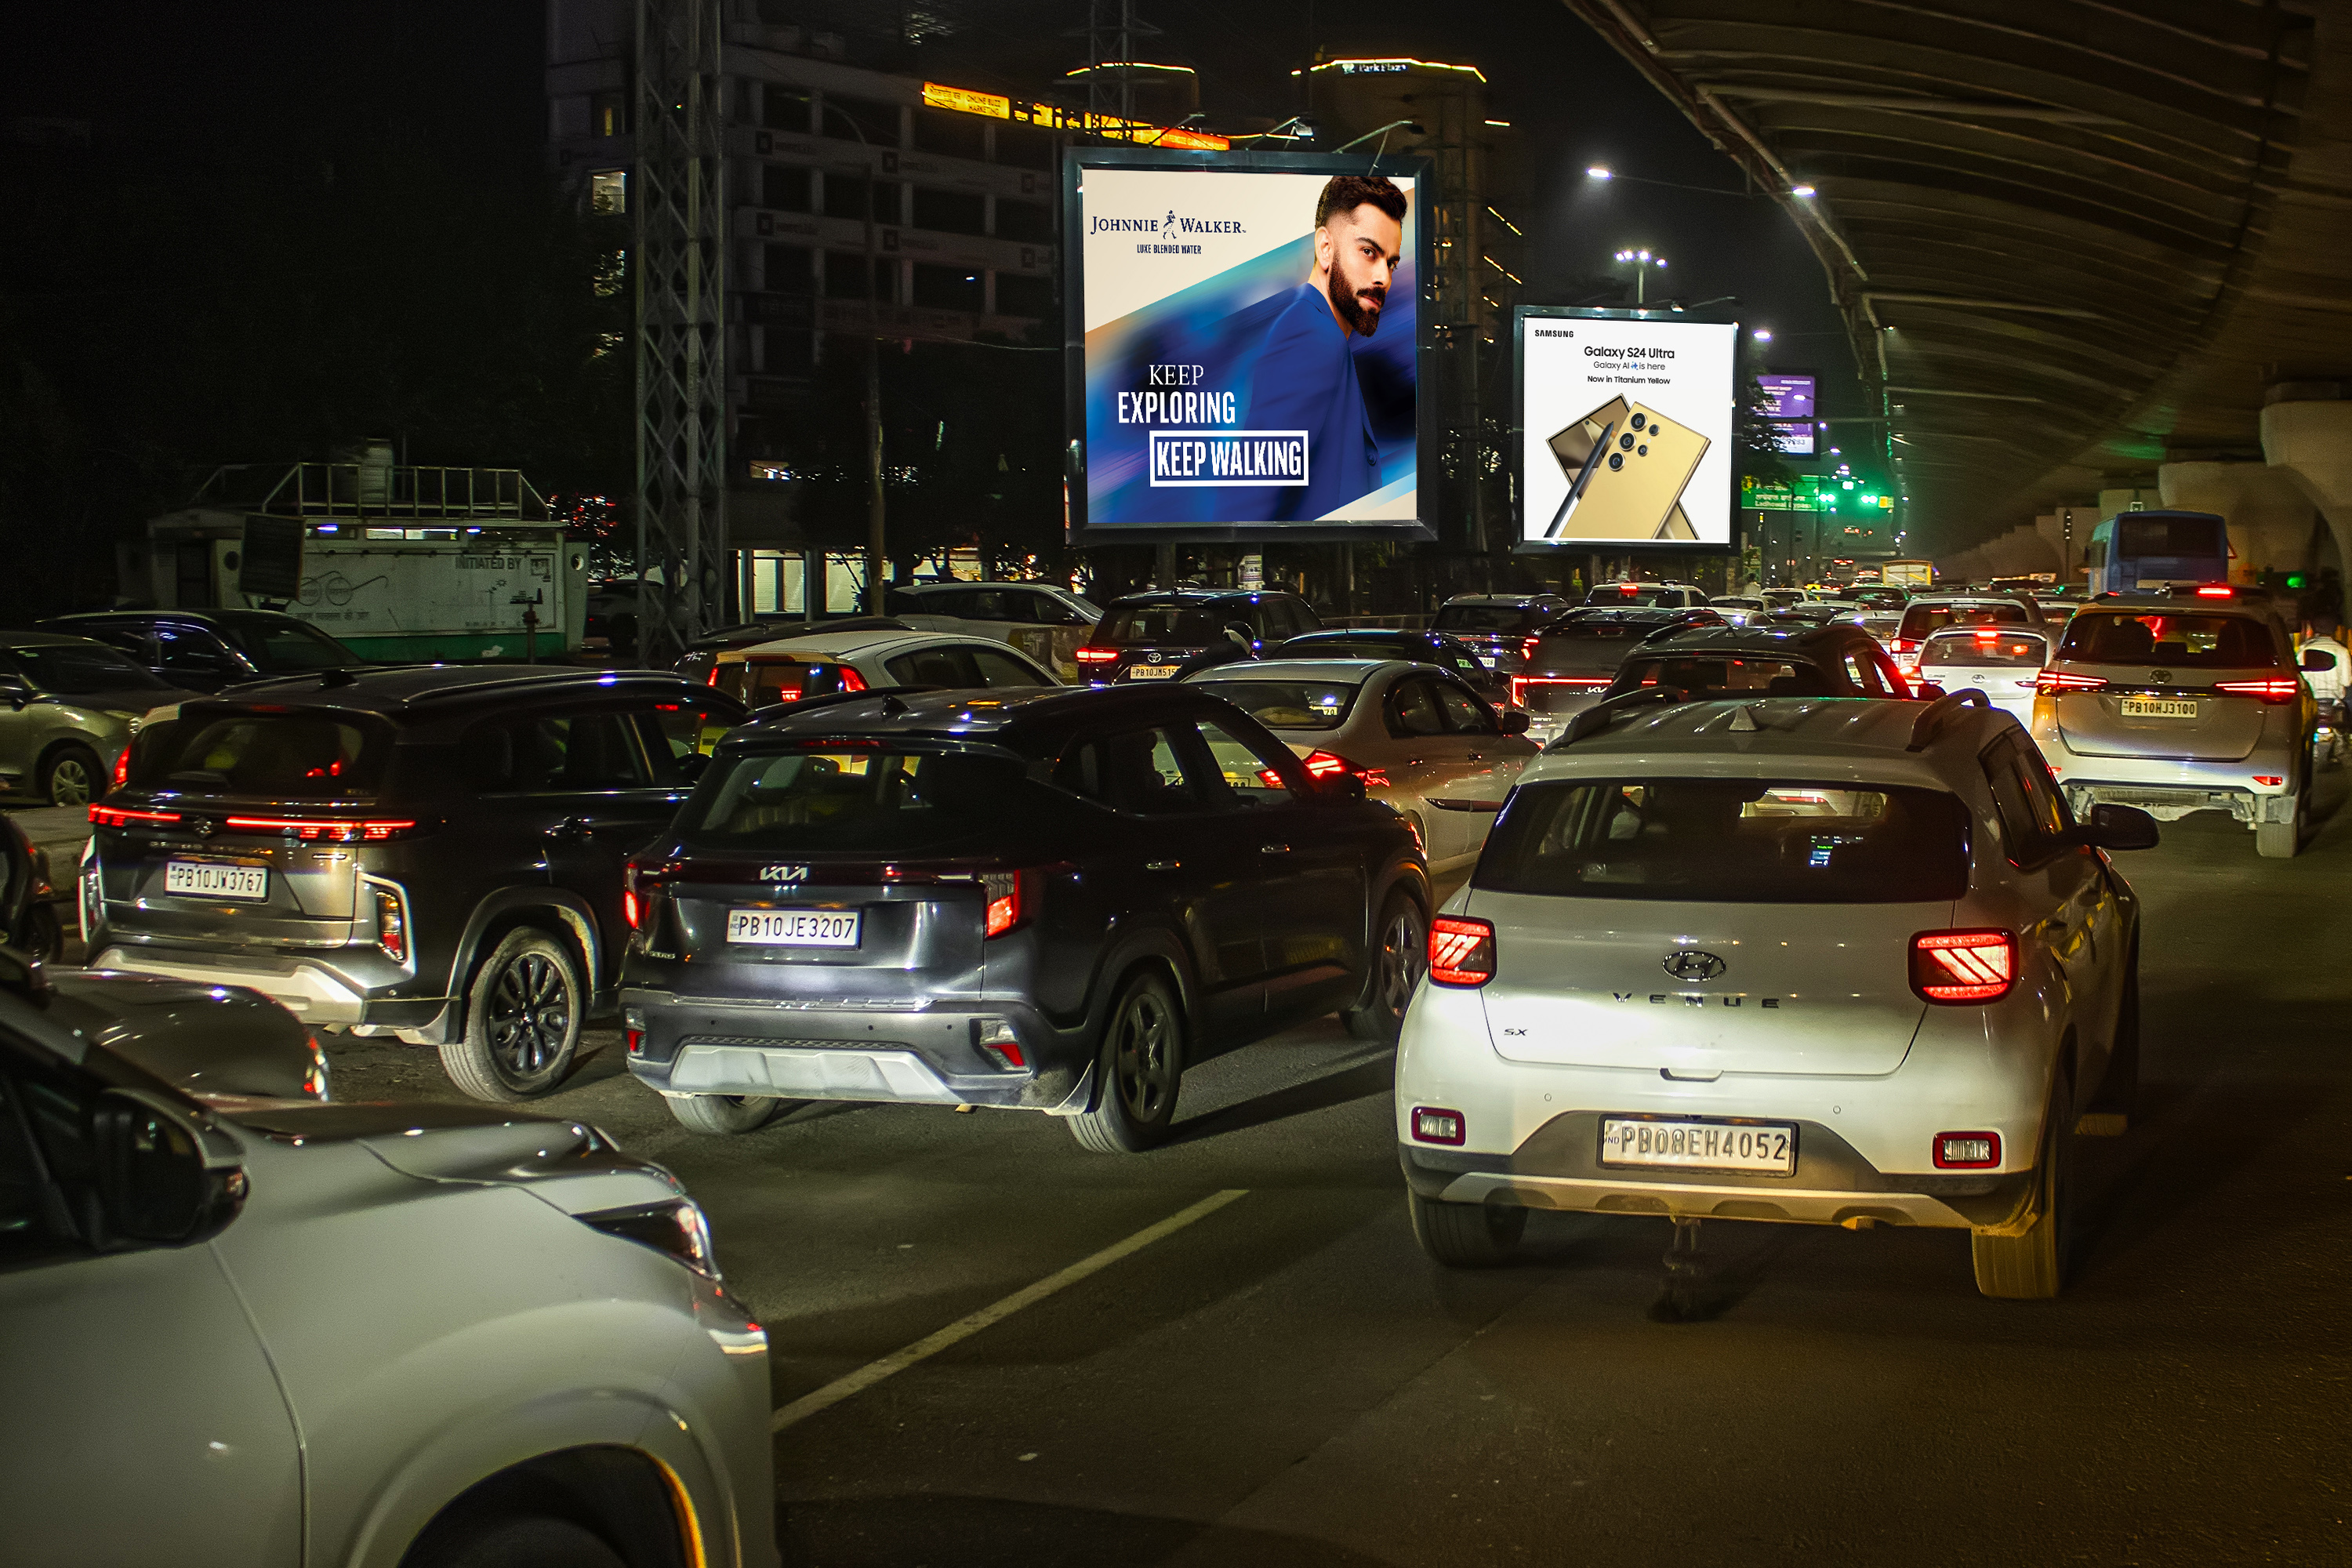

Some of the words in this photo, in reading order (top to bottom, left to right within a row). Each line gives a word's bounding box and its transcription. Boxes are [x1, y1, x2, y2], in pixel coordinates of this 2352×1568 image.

[966, 94, 986, 105] ONLINE
[968, 103, 1000, 115] MARKETING
[1090, 216, 1159, 235] JOHNNIE
[1179, 217, 1242, 234] WALKER
[1137, 244, 1152, 254] LUXE
[1153, 244, 1180, 254] BLENDED
[1181, 245, 1202, 255] WATER
[1534, 329, 1574, 338] SAMSUNG
[1584, 346, 1625, 360] Galaxy
[1627, 347, 1646, 358] S24
[1648, 347, 1675, 359] Ultra
[1593, 361, 1621, 371] Galaxy
[1149, 364, 1204, 386] KEEP
[1613, 376, 1646, 384] Titanium
[1118, 390, 1236, 424] EXPLORING
[1156, 441, 1207, 477] KEEP
[1210, 441, 1301, 476] WALKING
[455, 556, 504, 569] INITIATED
[507, 557, 521, 570] BY
[1135, 668, 1176, 677] PB10JM515
[2128, 701, 2195, 715] PB10HJ3100
[176, 868, 263, 893] PB10JW3767
[760, 866, 808, 881] KIA
[739, 915, 855, 939] PB10JE3207
[1613, 992, 1780, 1009] VENUE
[1503, 1028, 1528, 1036] SX
[1621, 1126, 1787, 1161] PB08EH4052
